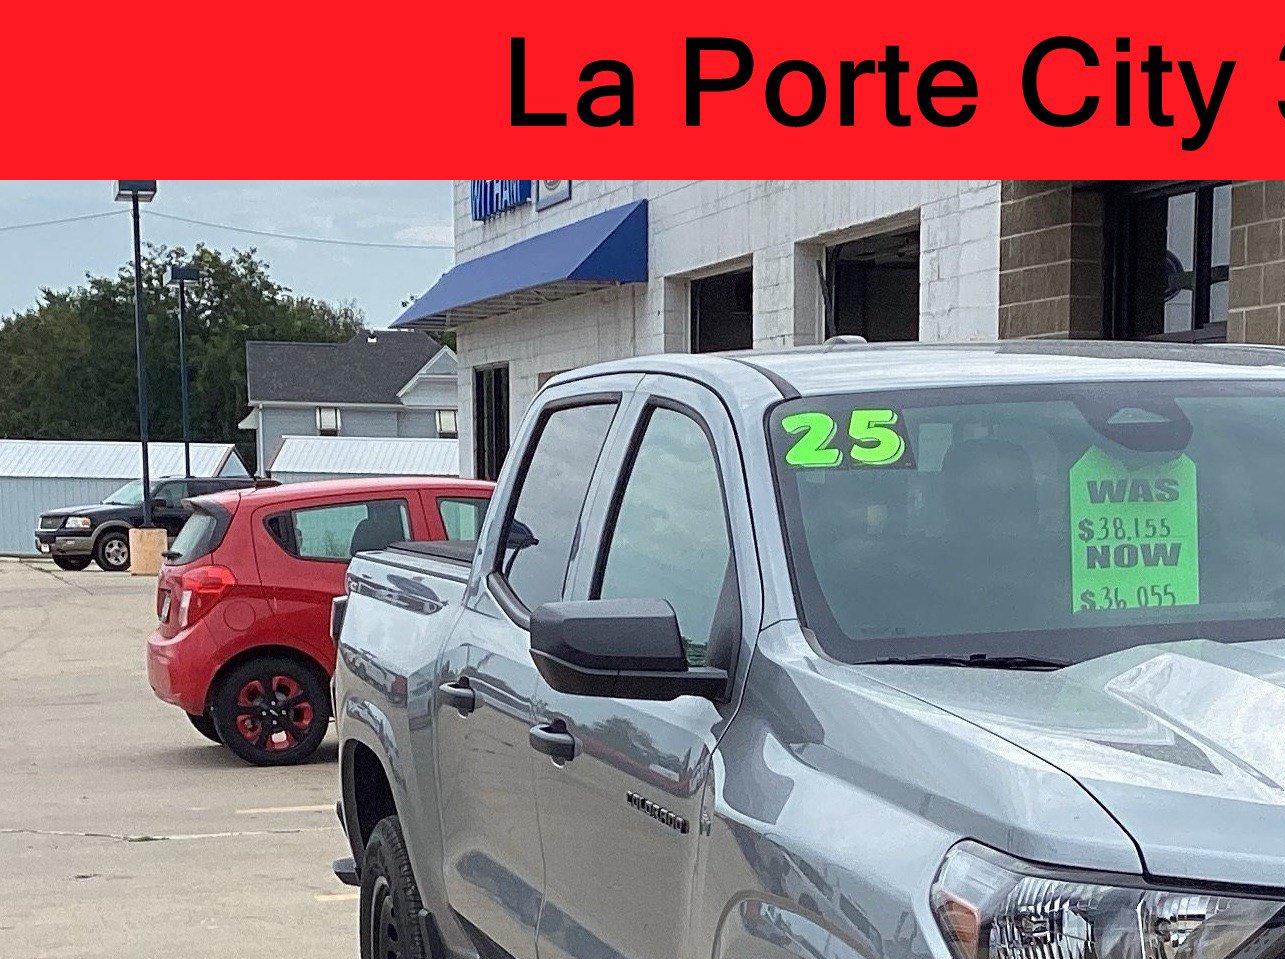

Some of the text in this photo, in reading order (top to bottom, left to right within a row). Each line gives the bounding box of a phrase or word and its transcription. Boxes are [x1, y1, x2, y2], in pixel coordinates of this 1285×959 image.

[781, 408, 905, 467] 25
[1086, 478, 1180, 504] WAS
[1086, 543, 1182, 569] NOW
